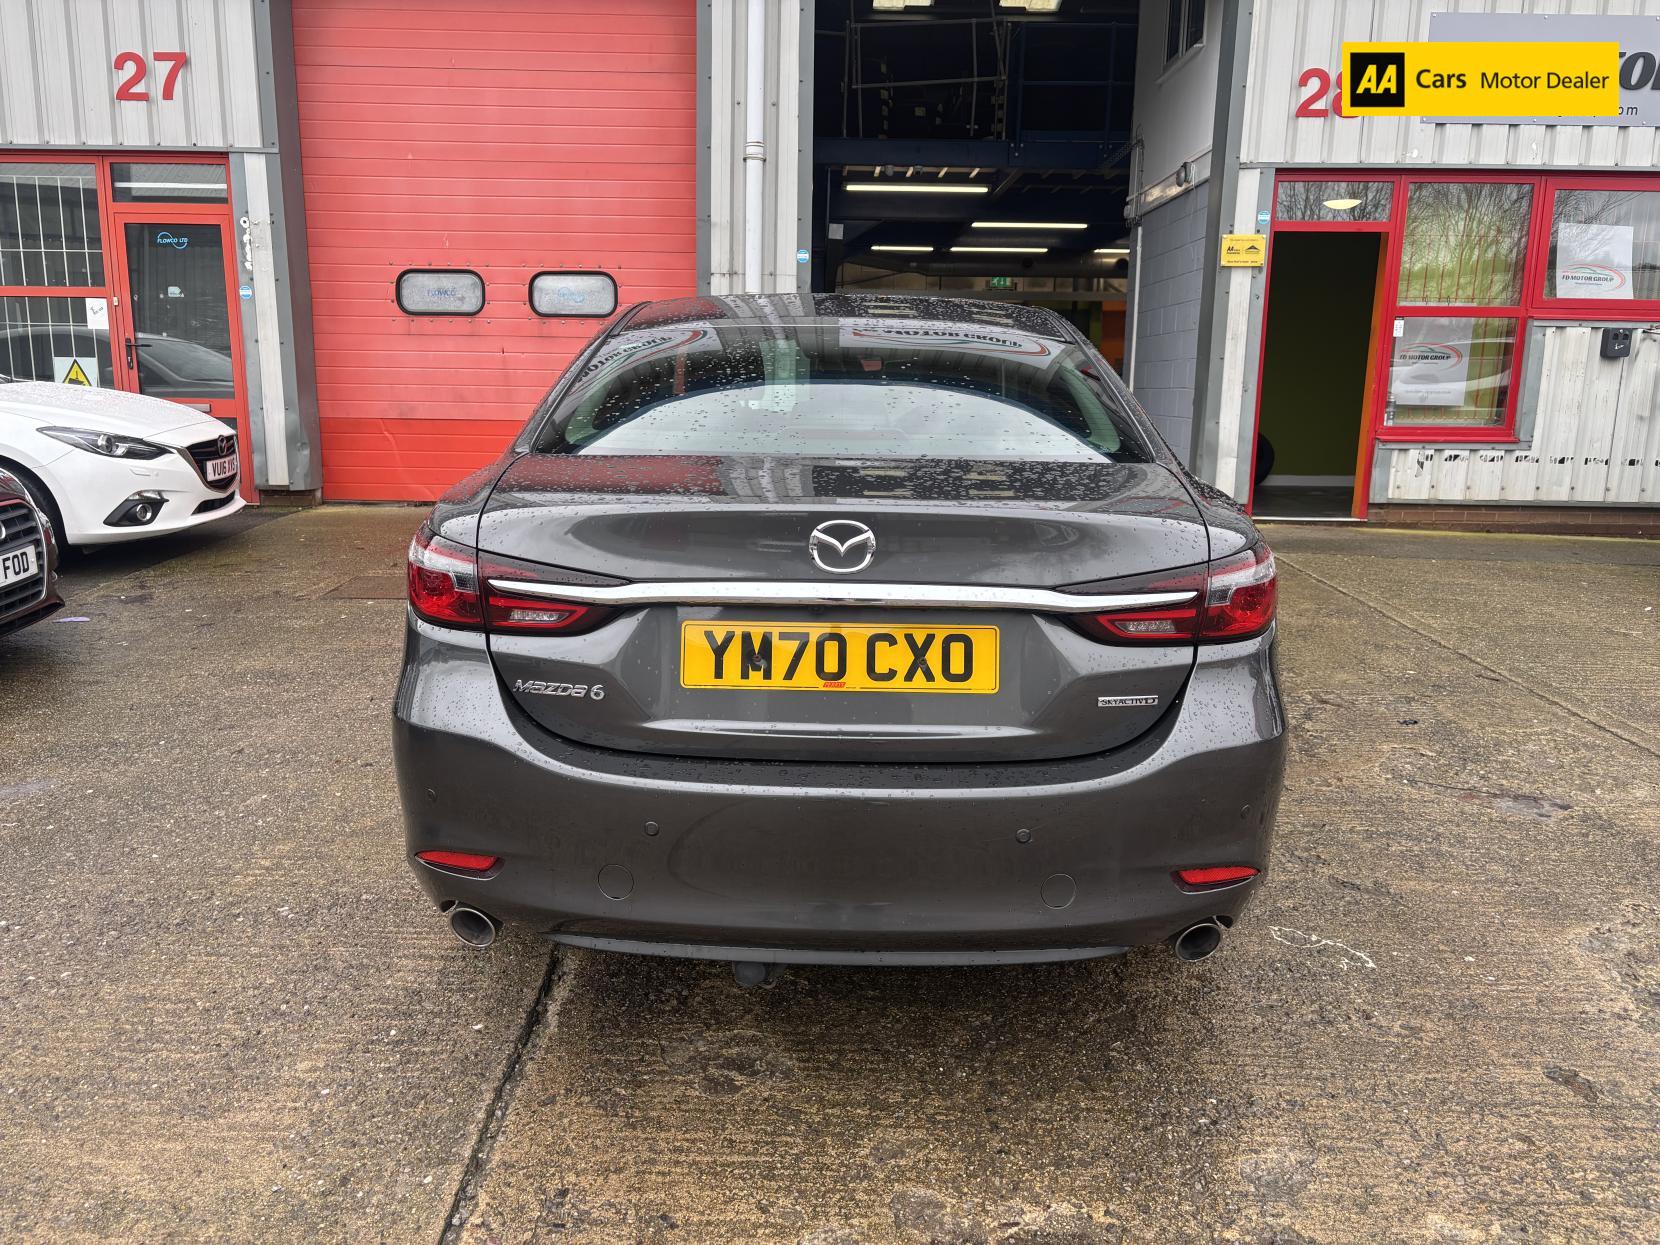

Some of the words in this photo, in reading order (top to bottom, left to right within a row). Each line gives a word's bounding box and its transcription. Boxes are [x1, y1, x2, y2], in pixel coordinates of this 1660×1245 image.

[114, 52, 187, 101] 27
[2, 551, 30, 580] FOD
[704, 630, 847, 682] YM70
[866, 633, 974, 682] CXO
[590, 684, 605, 701] 6
